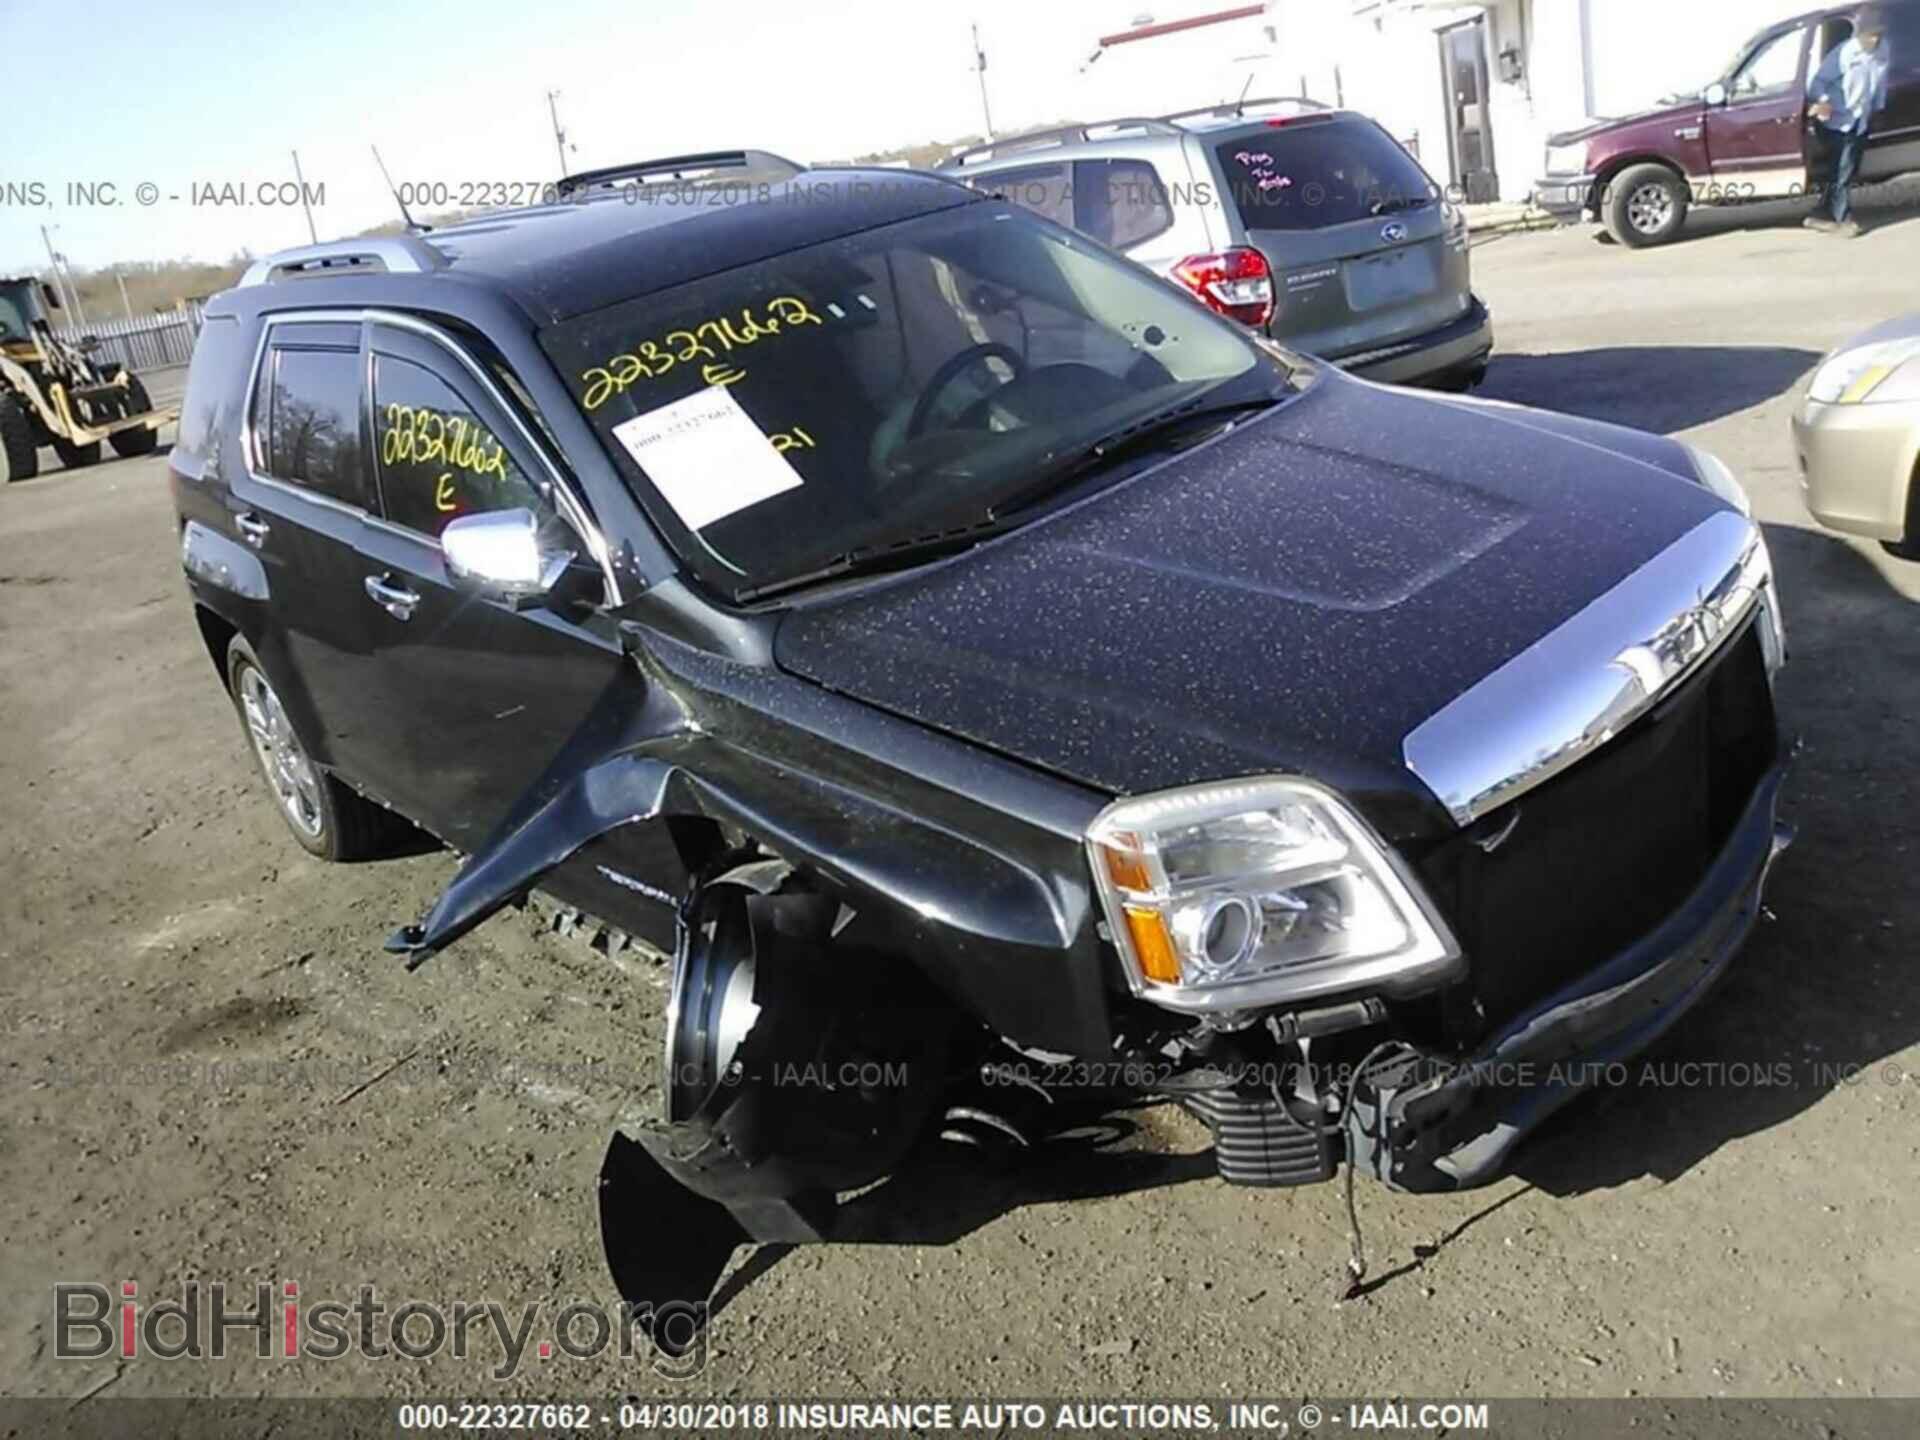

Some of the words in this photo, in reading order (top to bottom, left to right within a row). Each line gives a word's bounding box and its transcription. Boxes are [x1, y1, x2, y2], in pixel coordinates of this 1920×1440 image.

[583, 298, 823, 409] 22327662
[702, 363, 747, 385] E
[384, 402, 507, 481] 22327662
[435, 472, 457, 510] E
